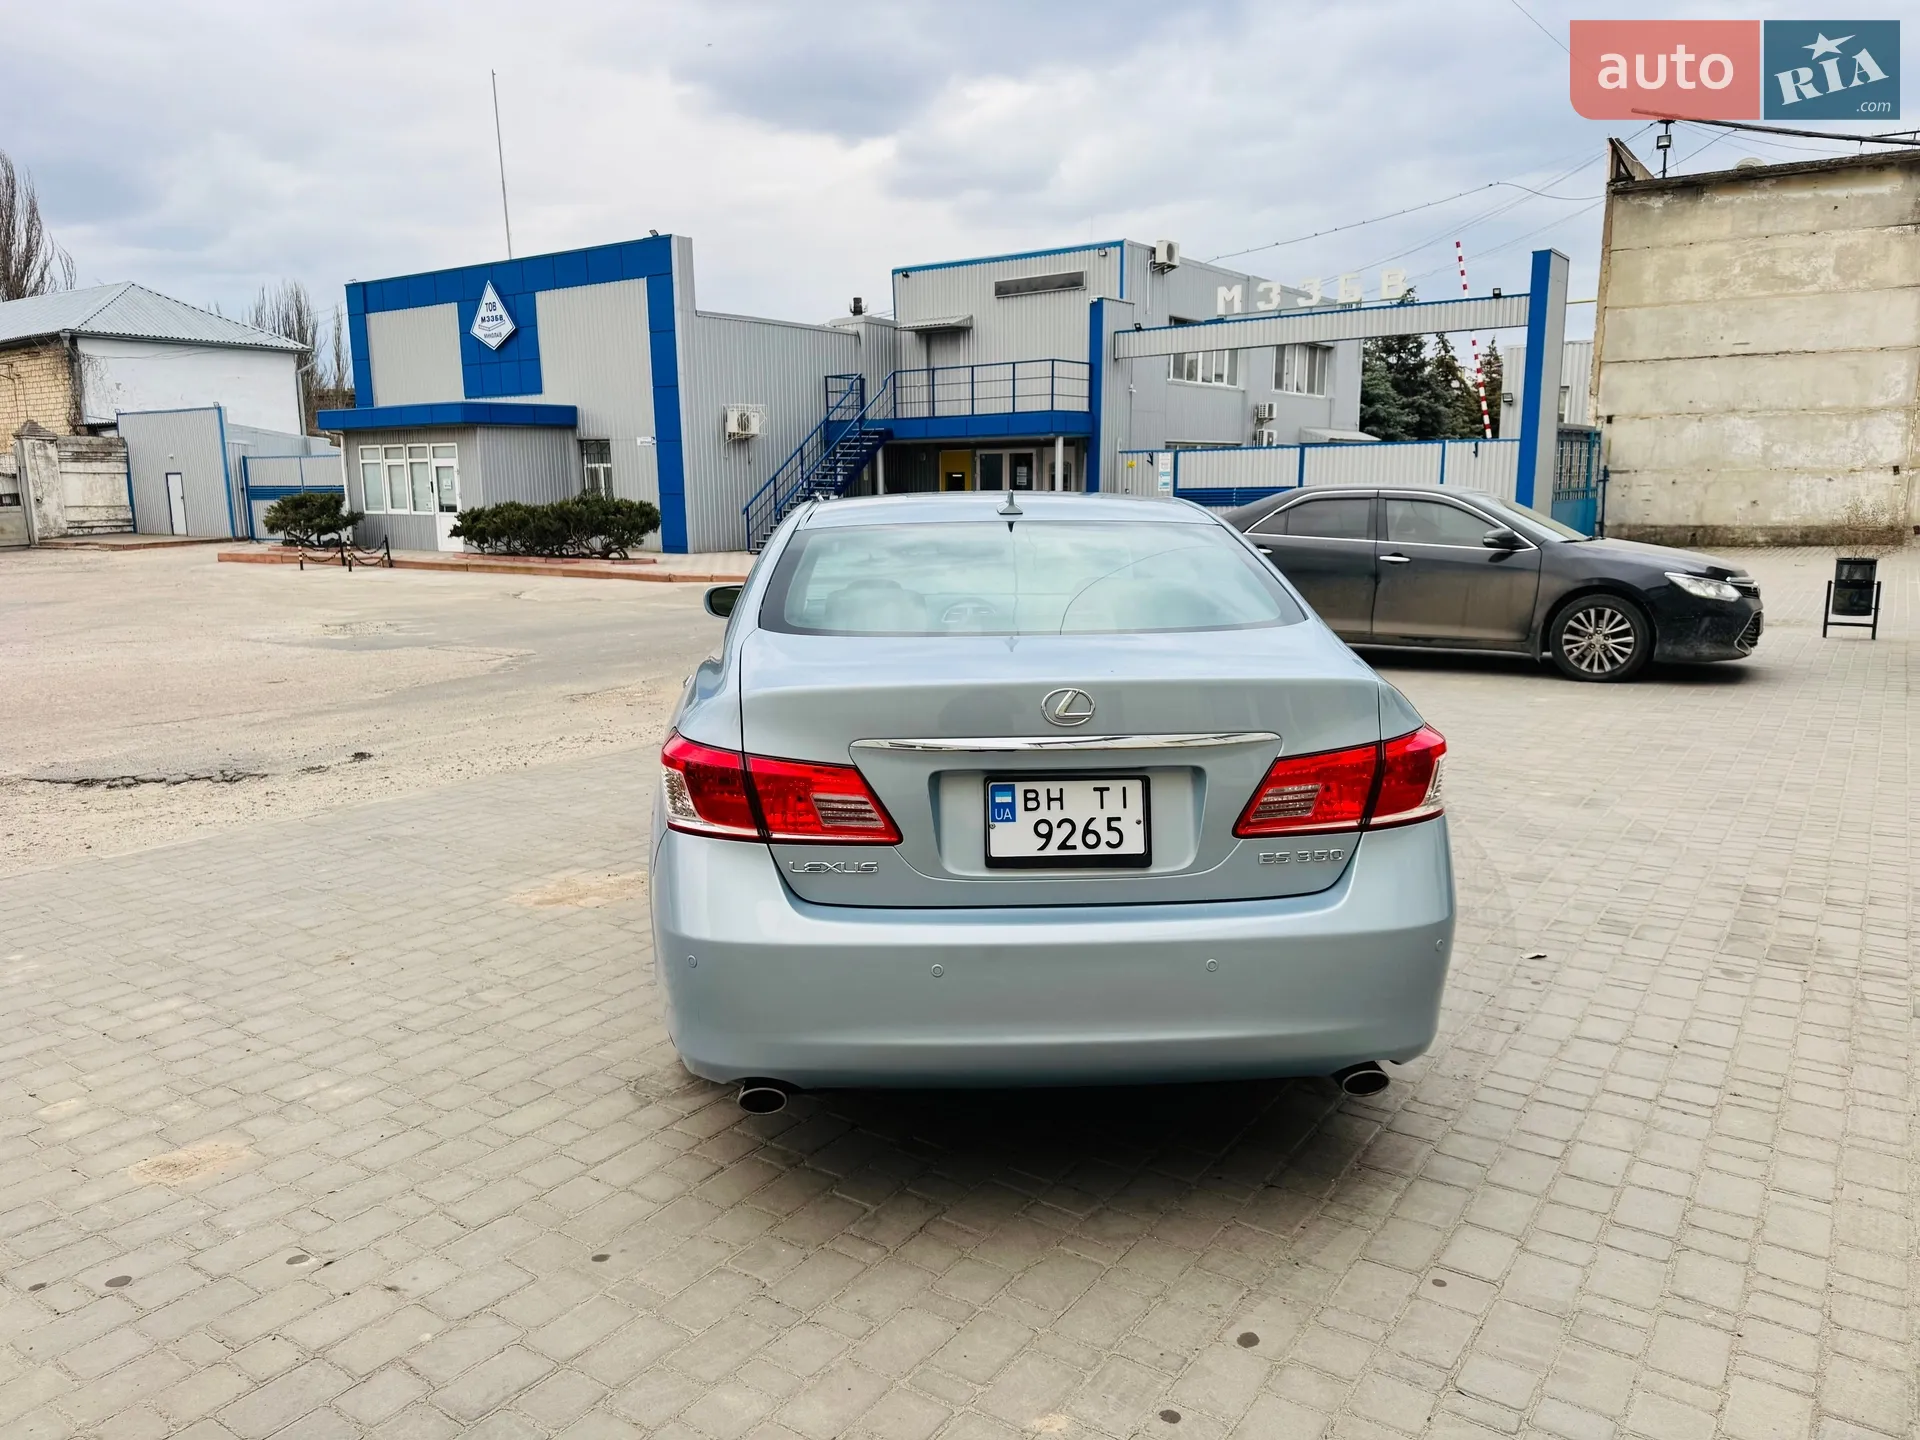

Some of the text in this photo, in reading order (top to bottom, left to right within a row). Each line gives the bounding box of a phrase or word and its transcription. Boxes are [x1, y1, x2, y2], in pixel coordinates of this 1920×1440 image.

[1023, 787, 1064, 812] BH
[994, 808, 1013, 820] UA
[1033, 816, 1124, 851] 9265
[1258, 848, 1345, 865] ES 350
[788, 861, 879, 874] LEXUS
